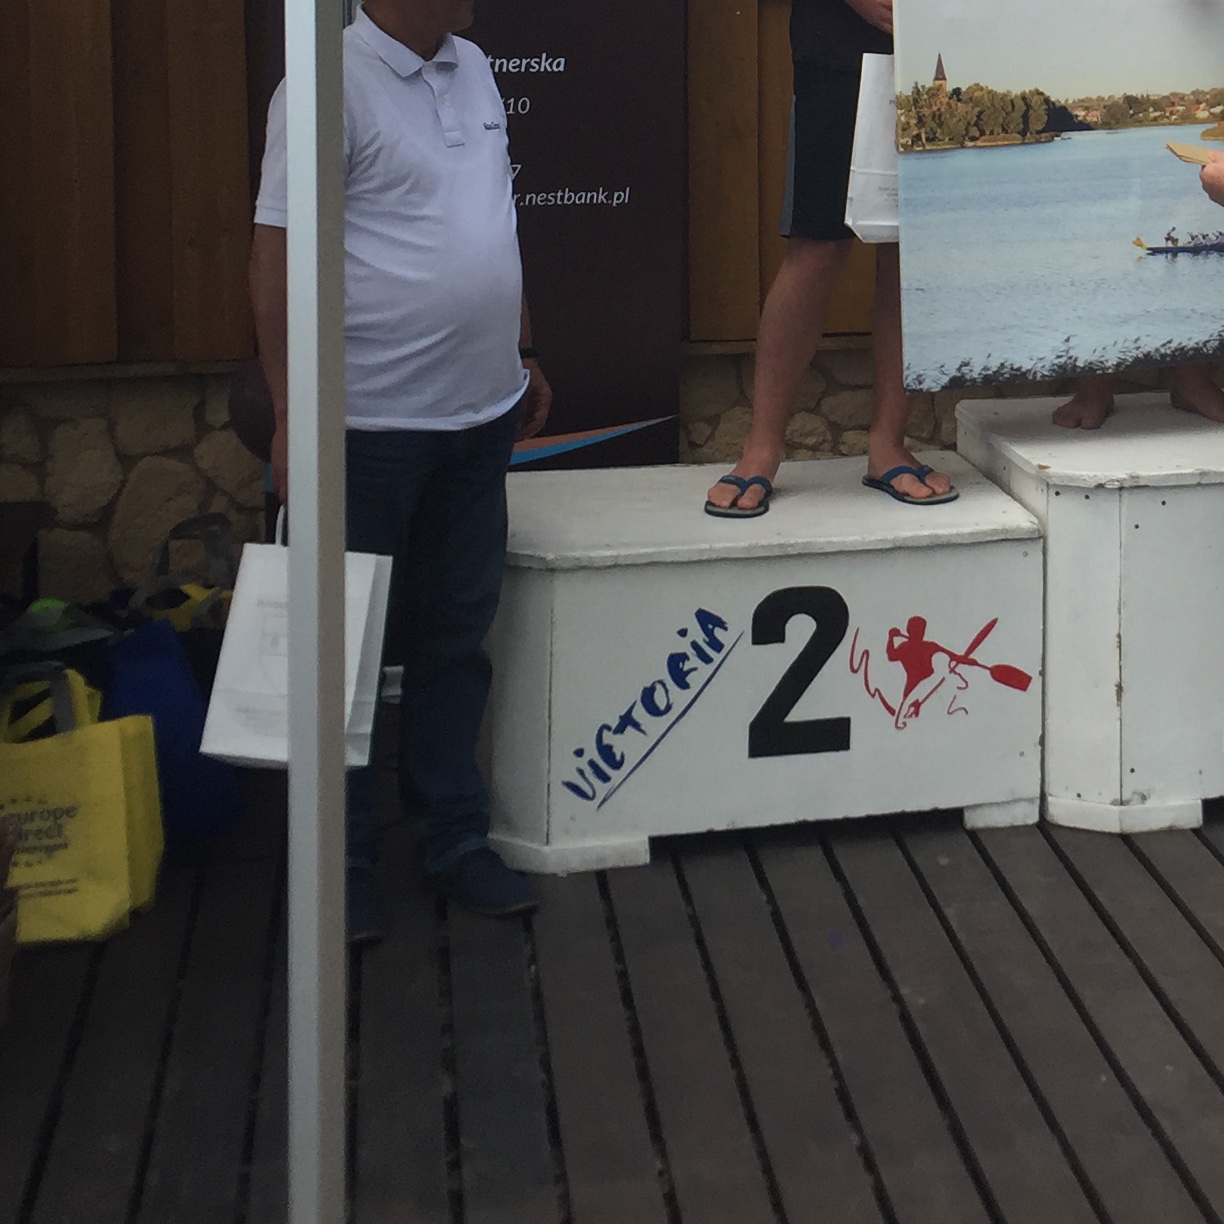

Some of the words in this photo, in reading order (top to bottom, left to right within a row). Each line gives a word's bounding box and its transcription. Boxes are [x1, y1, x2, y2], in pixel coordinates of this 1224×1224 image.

[487, 52, 566, 73] tnerska
[504, 96, 531, 115] 10
[513, 186, 631, 207] r.nestbank.pl
[747, 585, 851, 759] 2
